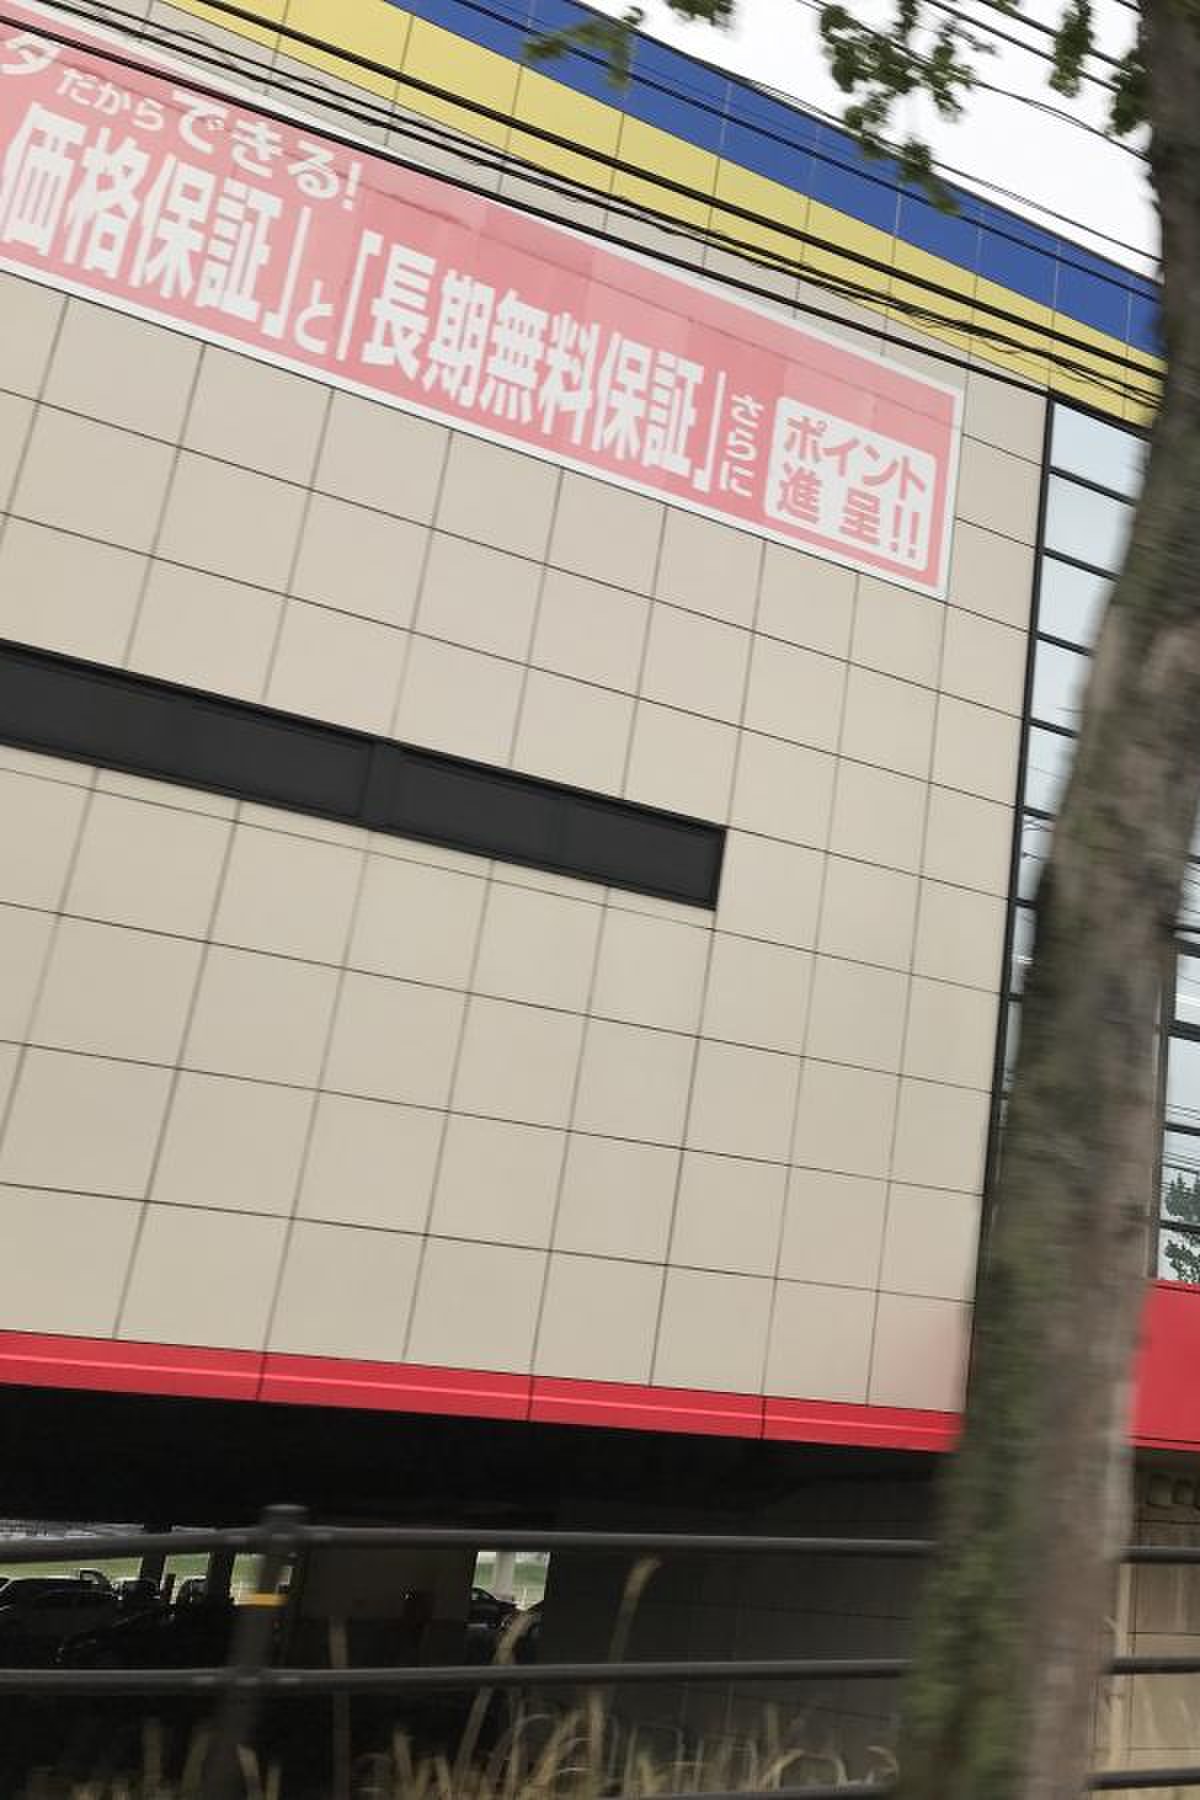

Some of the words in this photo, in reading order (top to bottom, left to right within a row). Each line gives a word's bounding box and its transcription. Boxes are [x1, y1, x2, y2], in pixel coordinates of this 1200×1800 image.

[720, 394, 764, 497] さらに
[783, 416, 926, 500] ポイント
